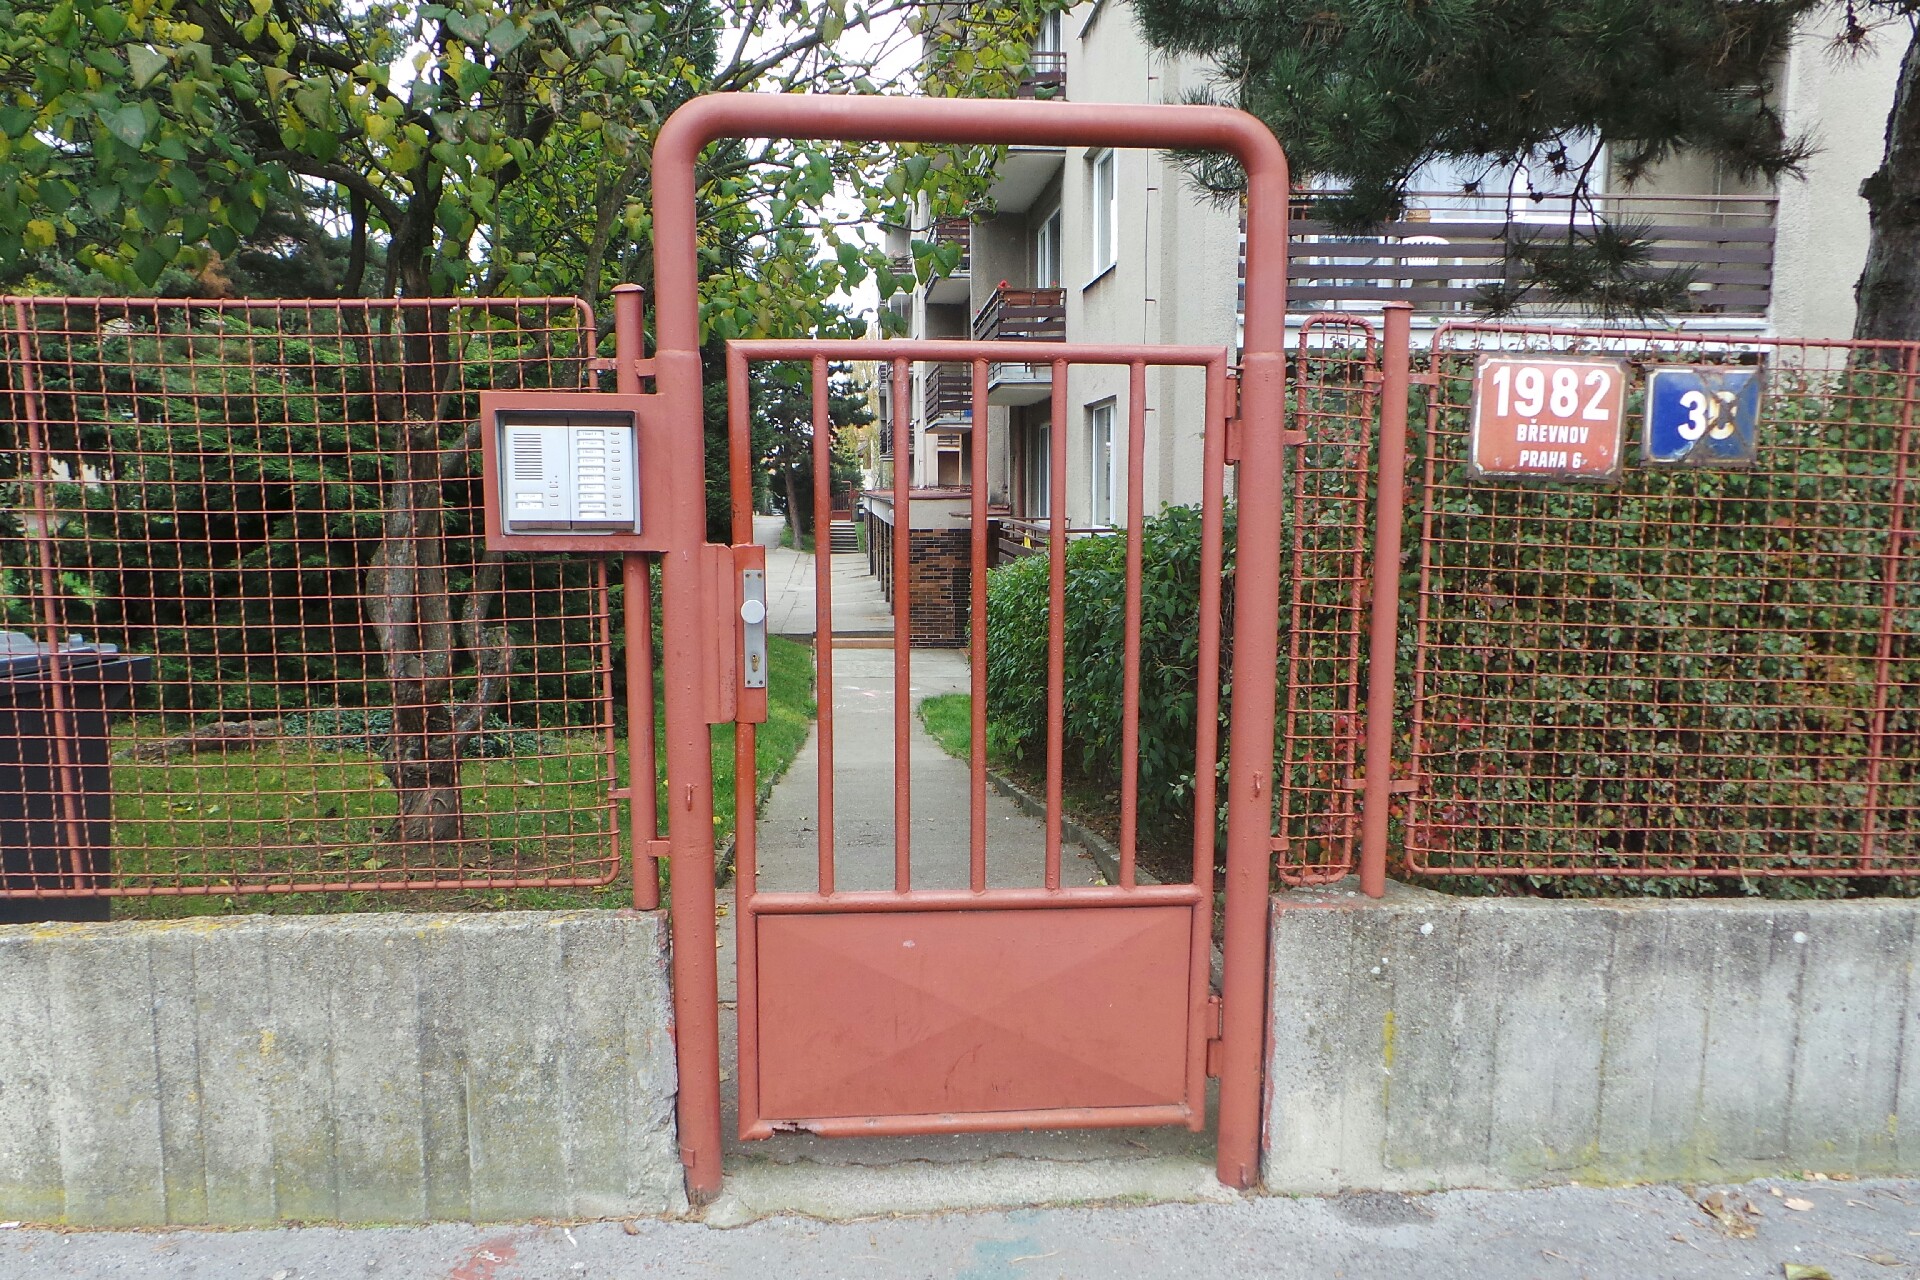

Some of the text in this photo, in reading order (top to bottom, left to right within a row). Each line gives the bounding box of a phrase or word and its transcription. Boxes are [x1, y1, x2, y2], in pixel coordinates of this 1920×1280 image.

[1492, 365, 1611, 421] 1982
[1516, 418, 1590, 444] BŘEVNOV
[1519, 449, 1583, 469] PRAHA 6
